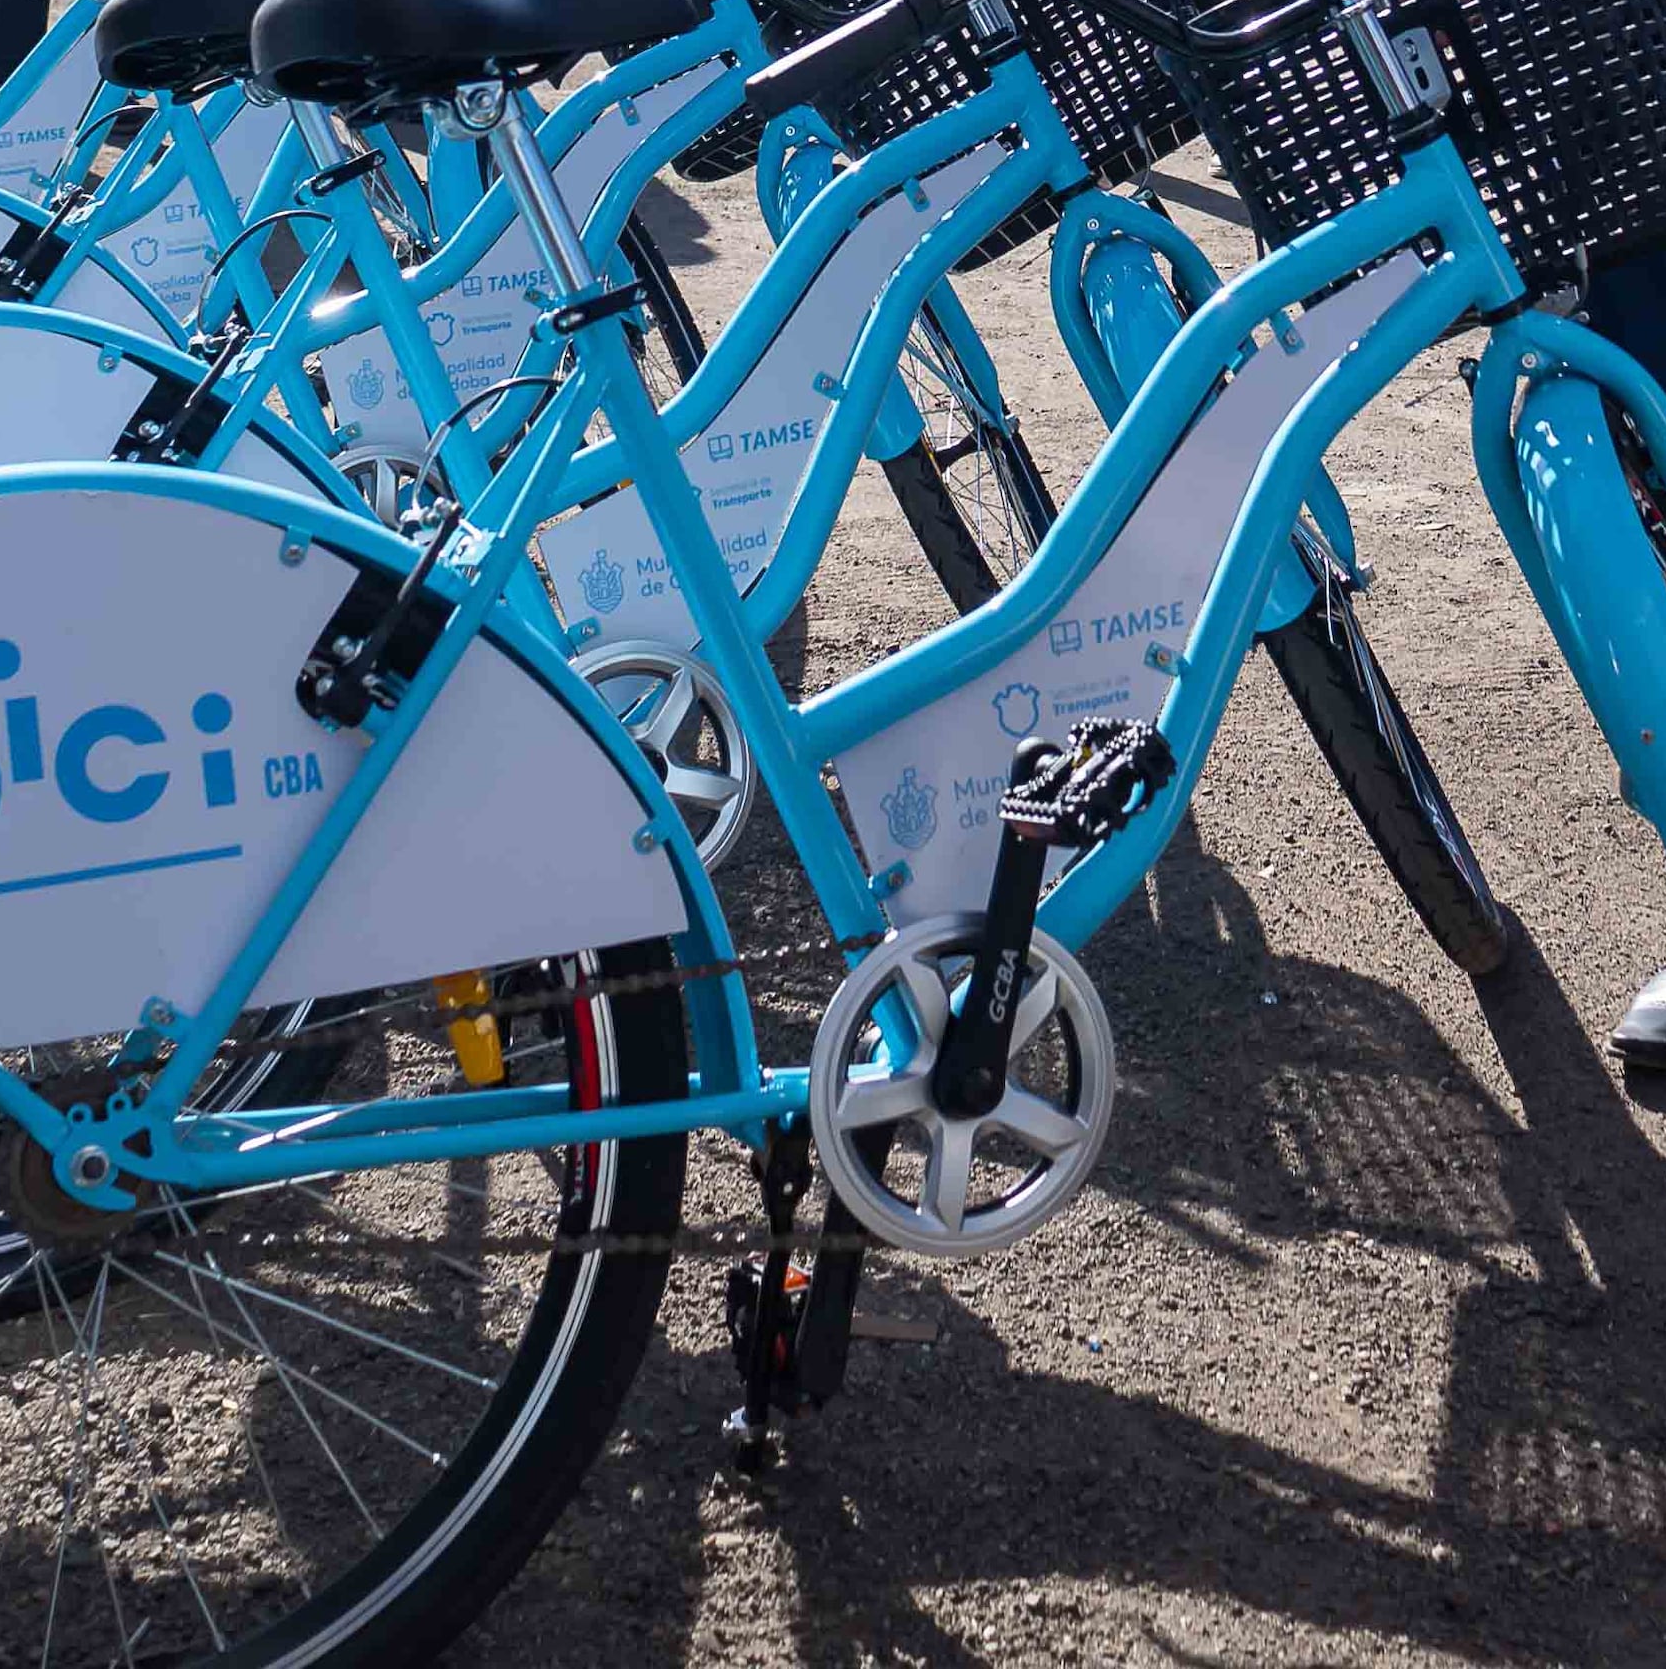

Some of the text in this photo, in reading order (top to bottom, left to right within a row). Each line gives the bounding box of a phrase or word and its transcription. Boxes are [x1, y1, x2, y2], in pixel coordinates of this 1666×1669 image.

[17, 127, 66, 144] TAMSE
[487, 269, 549, 293] TAMSE
[740, 419, 815, 455] TAMSE
[712, 489, 773, 511] Transporte
[640, 580, 665, 598] de
[1090, 601, 1185, 644] TAMSE
[1052, 689, 1131, 717] Transporte
[263, 752, 325, 799] CBA
[958, 806, 984, 829] de
[989, 948, 1020, 1024] GCBA
